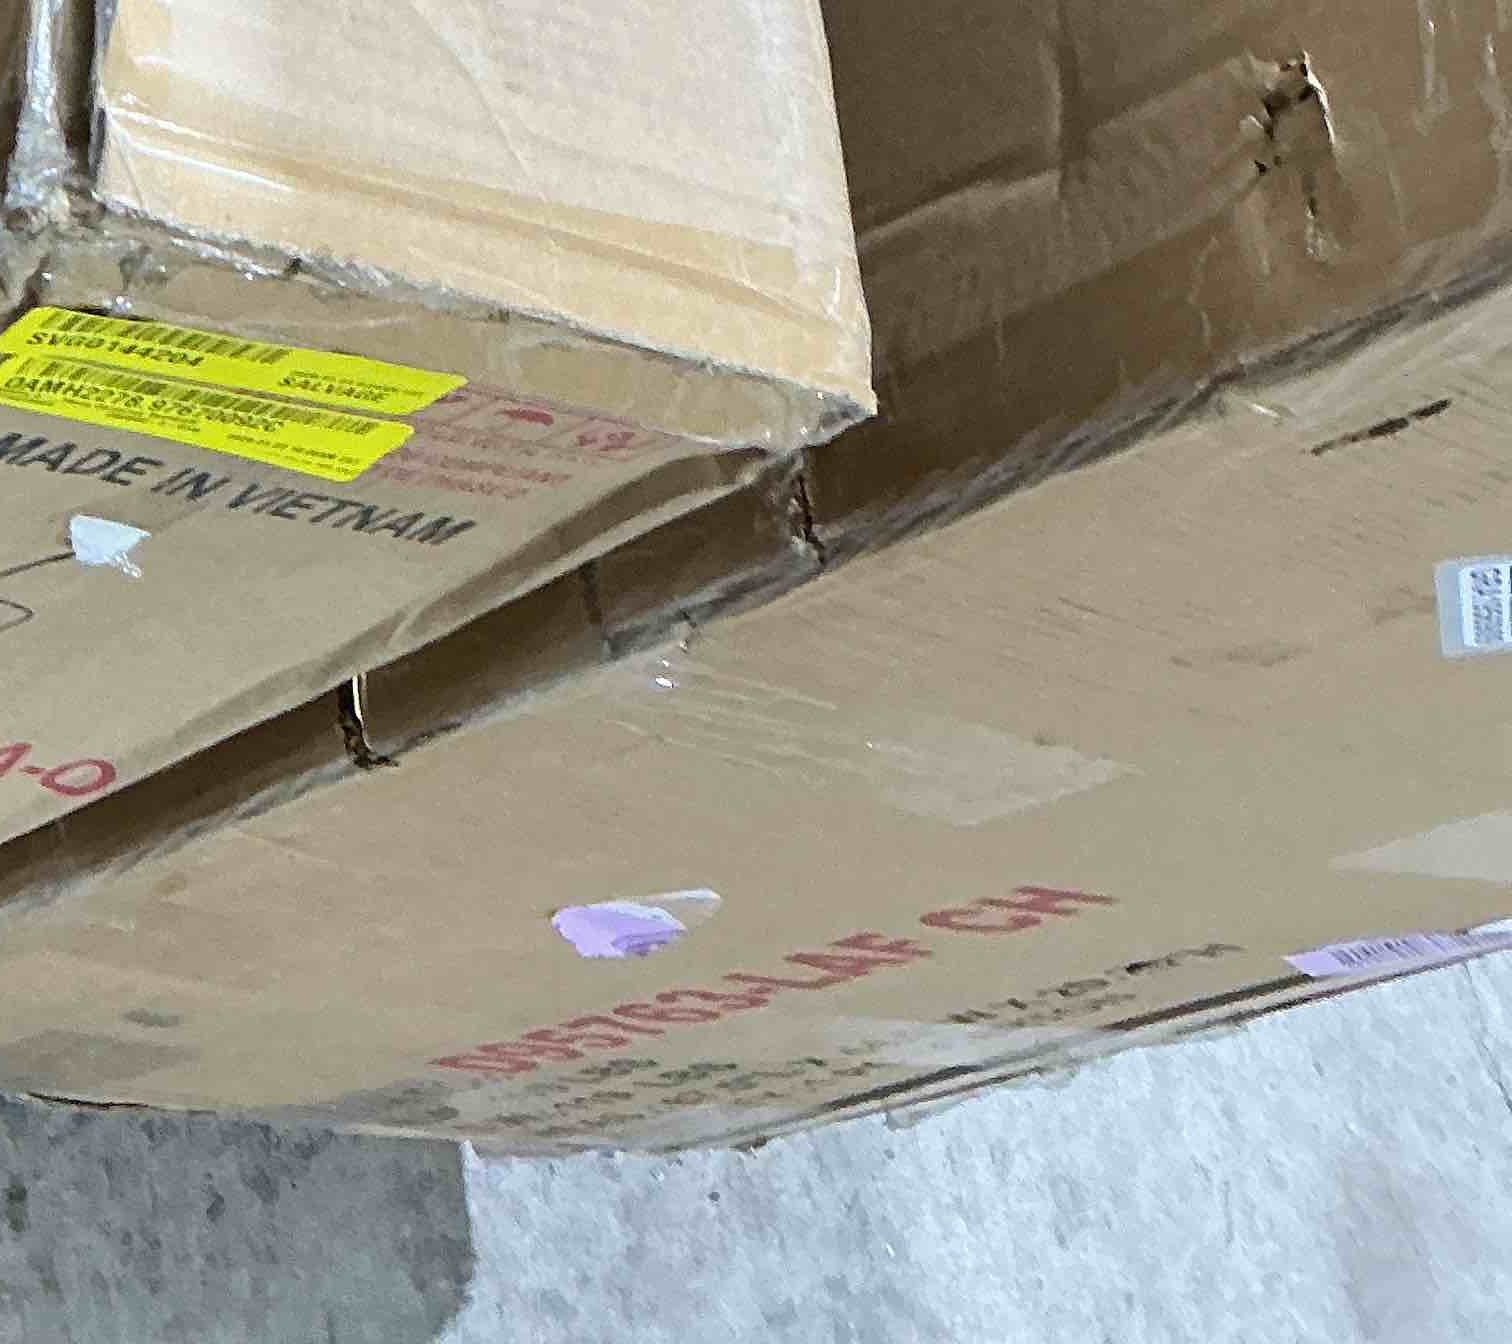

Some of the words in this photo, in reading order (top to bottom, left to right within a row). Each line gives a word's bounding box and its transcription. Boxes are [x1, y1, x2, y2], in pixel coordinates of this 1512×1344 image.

[151, 468, 232, 502] IN
[227, 484, 477, 545] VIETNAM
[919, 884, 1122, 937] CH
